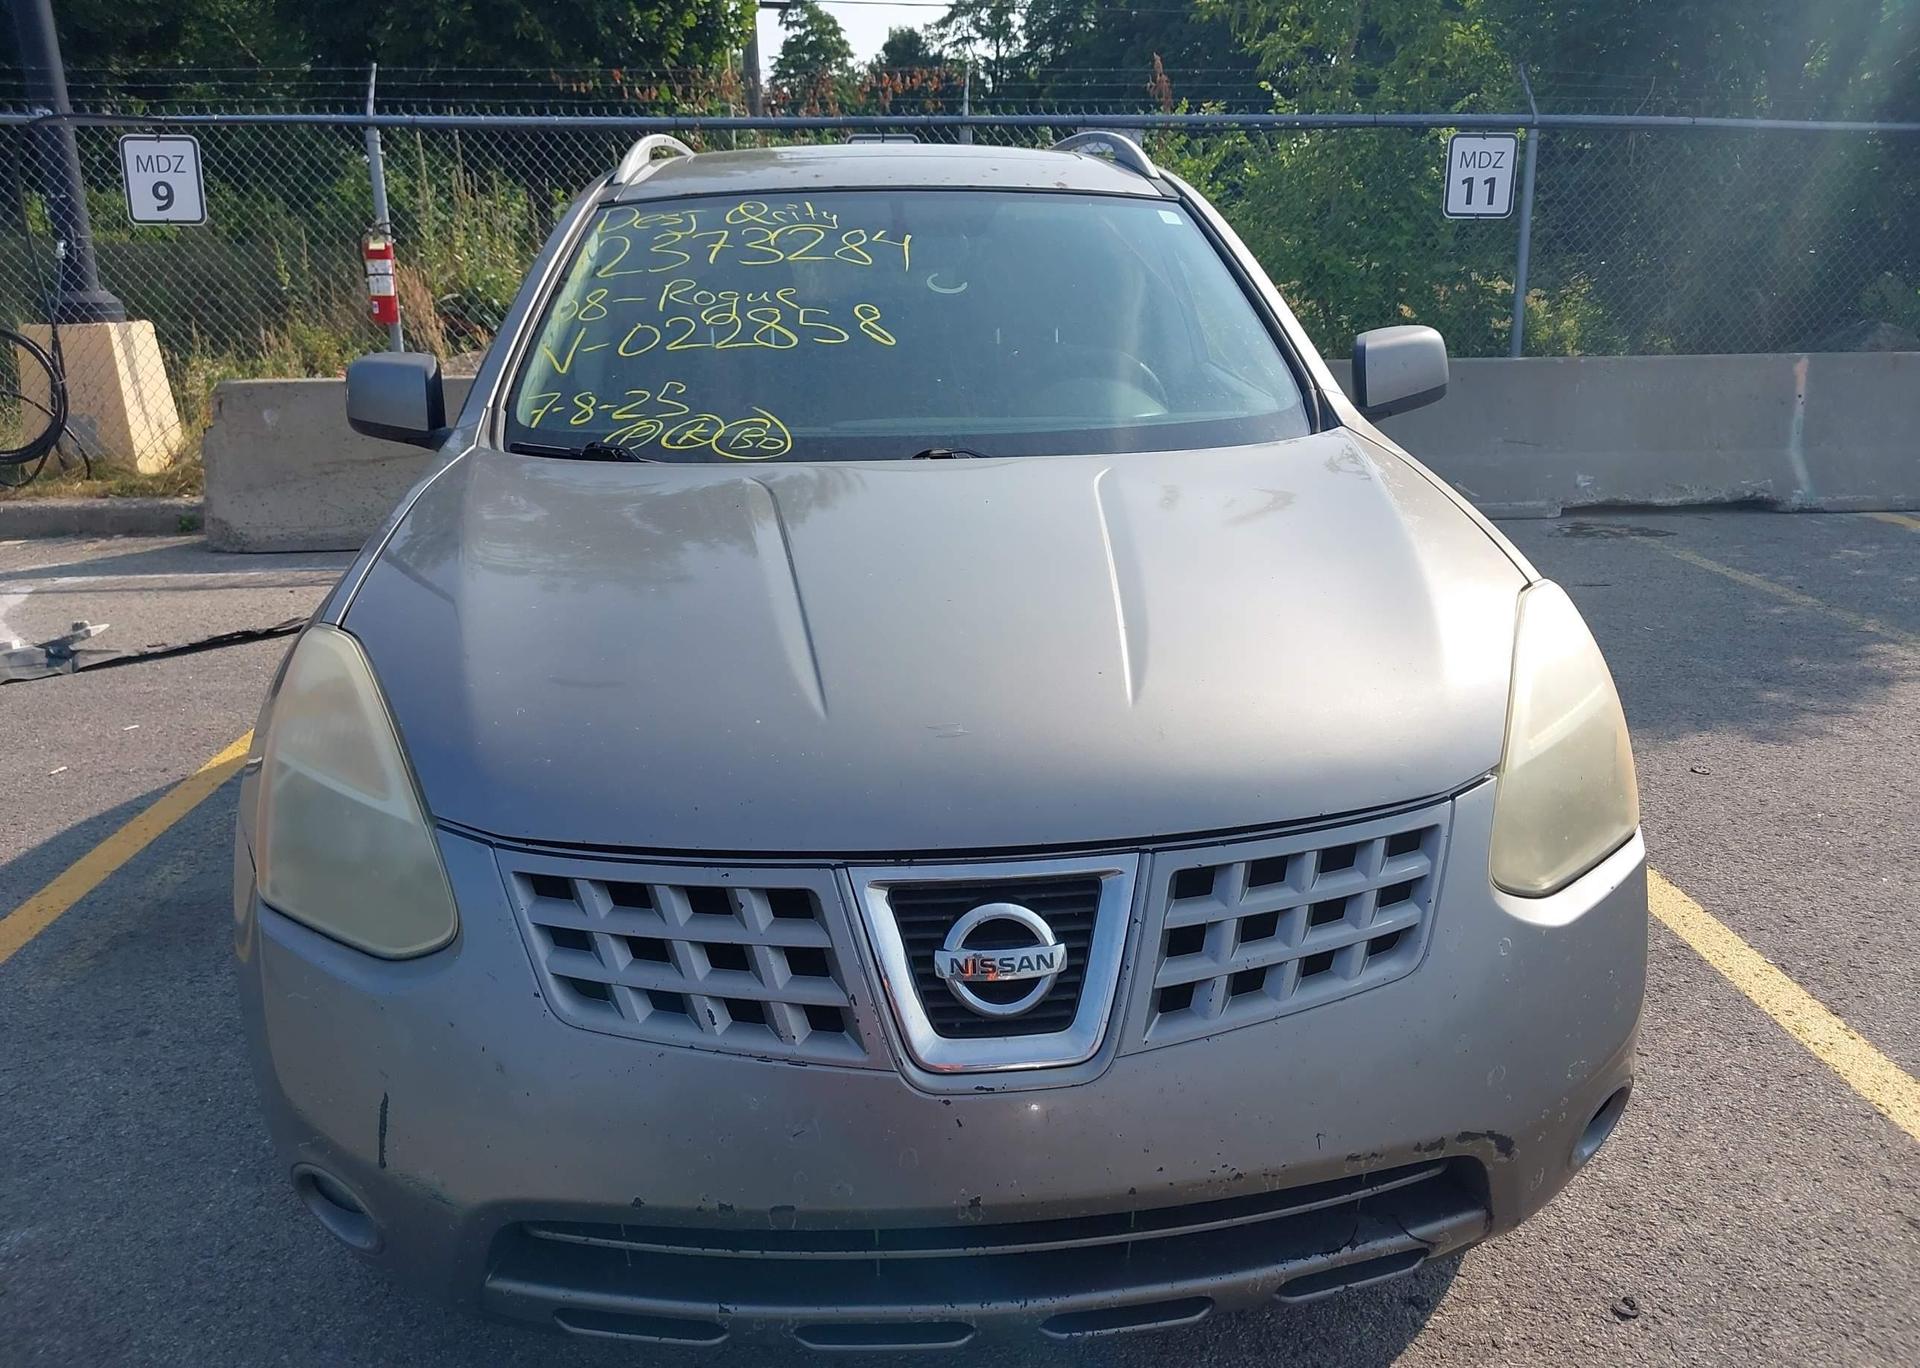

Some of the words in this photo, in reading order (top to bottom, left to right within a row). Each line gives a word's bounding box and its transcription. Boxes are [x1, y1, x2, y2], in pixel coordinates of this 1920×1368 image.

[136, 154, 187, 173] MDZ
[1460, 151, 1505, 169] MDZ
[151, 180, 175, 212] 9
[1461, 176, 1497, 206] 11
[596, 228, 912, 279] 2373284
[528, 381, 690, 429] 7-8-25
[950, 951, 1055, 976] NISSAN
